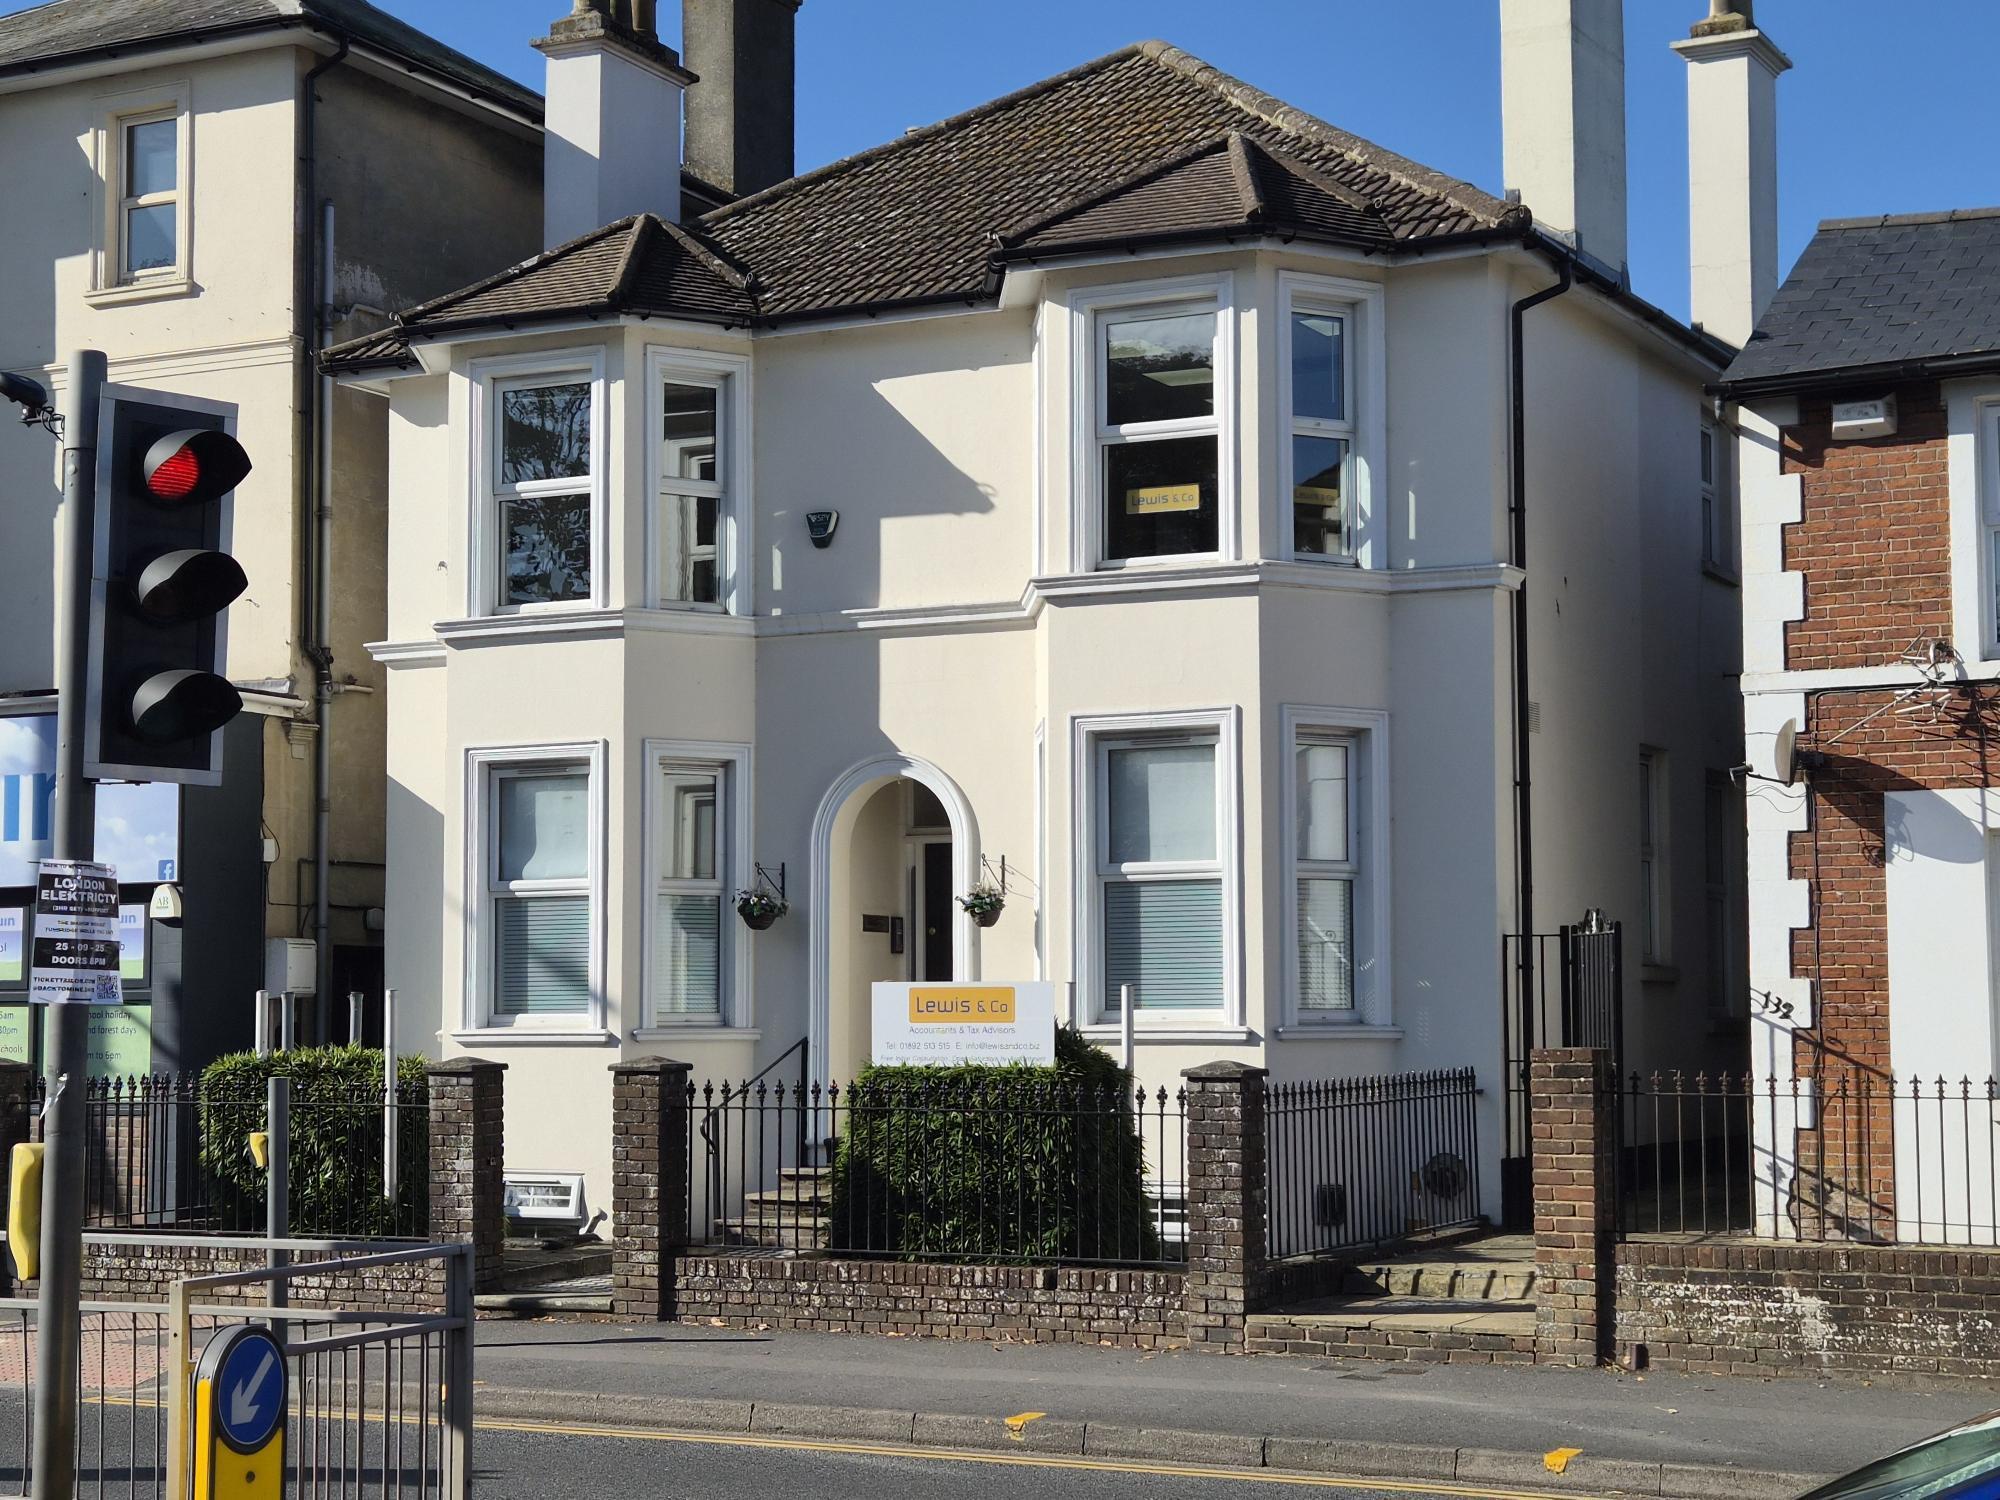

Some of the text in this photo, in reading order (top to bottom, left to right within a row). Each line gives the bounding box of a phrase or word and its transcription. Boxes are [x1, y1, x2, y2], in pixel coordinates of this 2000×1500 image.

[1131, 494, 1169, 506] Lewis
[1182, 493, 1194, 502] Co
[54, 878, 105, 891] LONDON
[41, 890, 117, 904] ELEKTRICTY
[55, 942, 69, 951] 25
[77, 943, 89, 952] 09
[95, 944, 105, 952] 25
[51, 955, 88, 965] DOORS
[916, 996, 1008, 1013] Lewis & Co
[1762, 990, 1795, 1020] 132
[98, 1026, 119, 1034] forest
[120, 1026, 137, 1037] days
[909, 1026, 1016, 1035] Accountants & Tax Advisors
[899, 1042, 921, 1050] 01892
[923, 1042, 936, 1050] 513
[938, 1042, 951, 1050] 515
